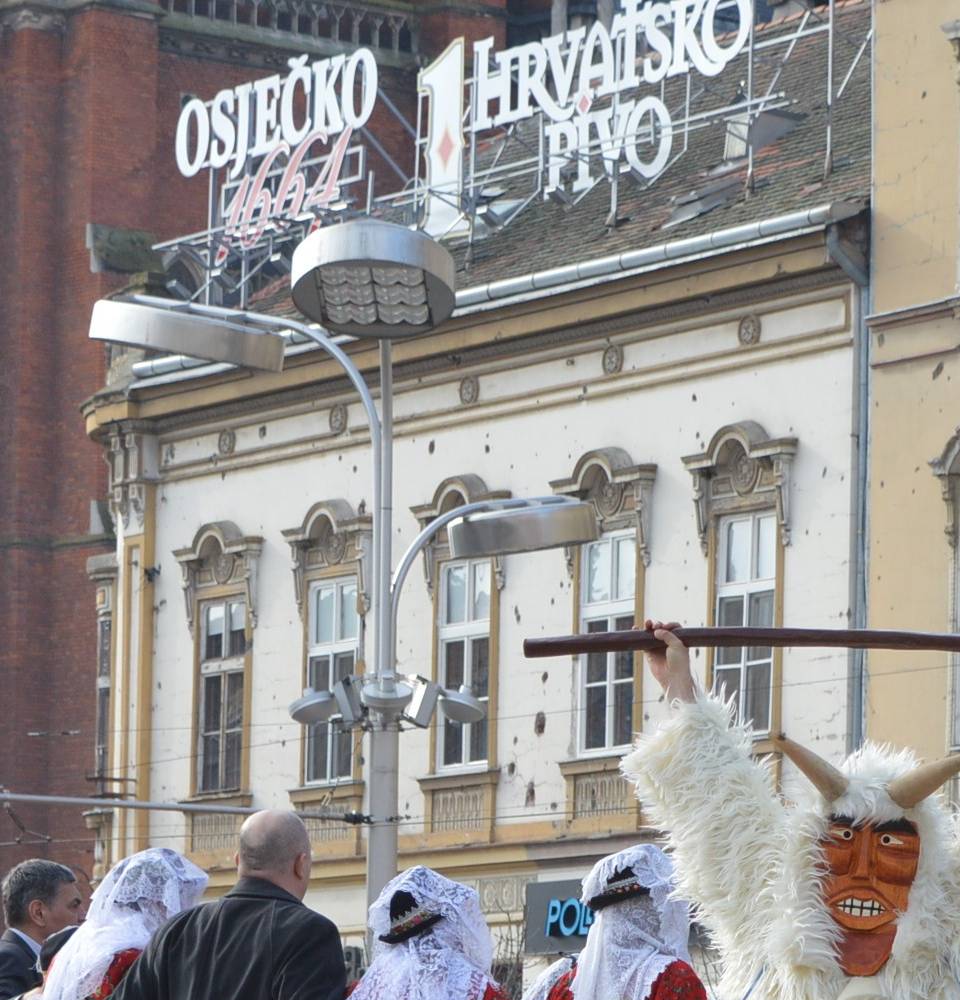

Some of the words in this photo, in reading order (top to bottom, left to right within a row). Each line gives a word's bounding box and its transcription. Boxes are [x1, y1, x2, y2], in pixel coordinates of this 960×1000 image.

[175, 47, 378, 179] OSJEČKO
[472, 0, 751, 132] HRVATSKO
[543, 96, 673, 201] PIVO
